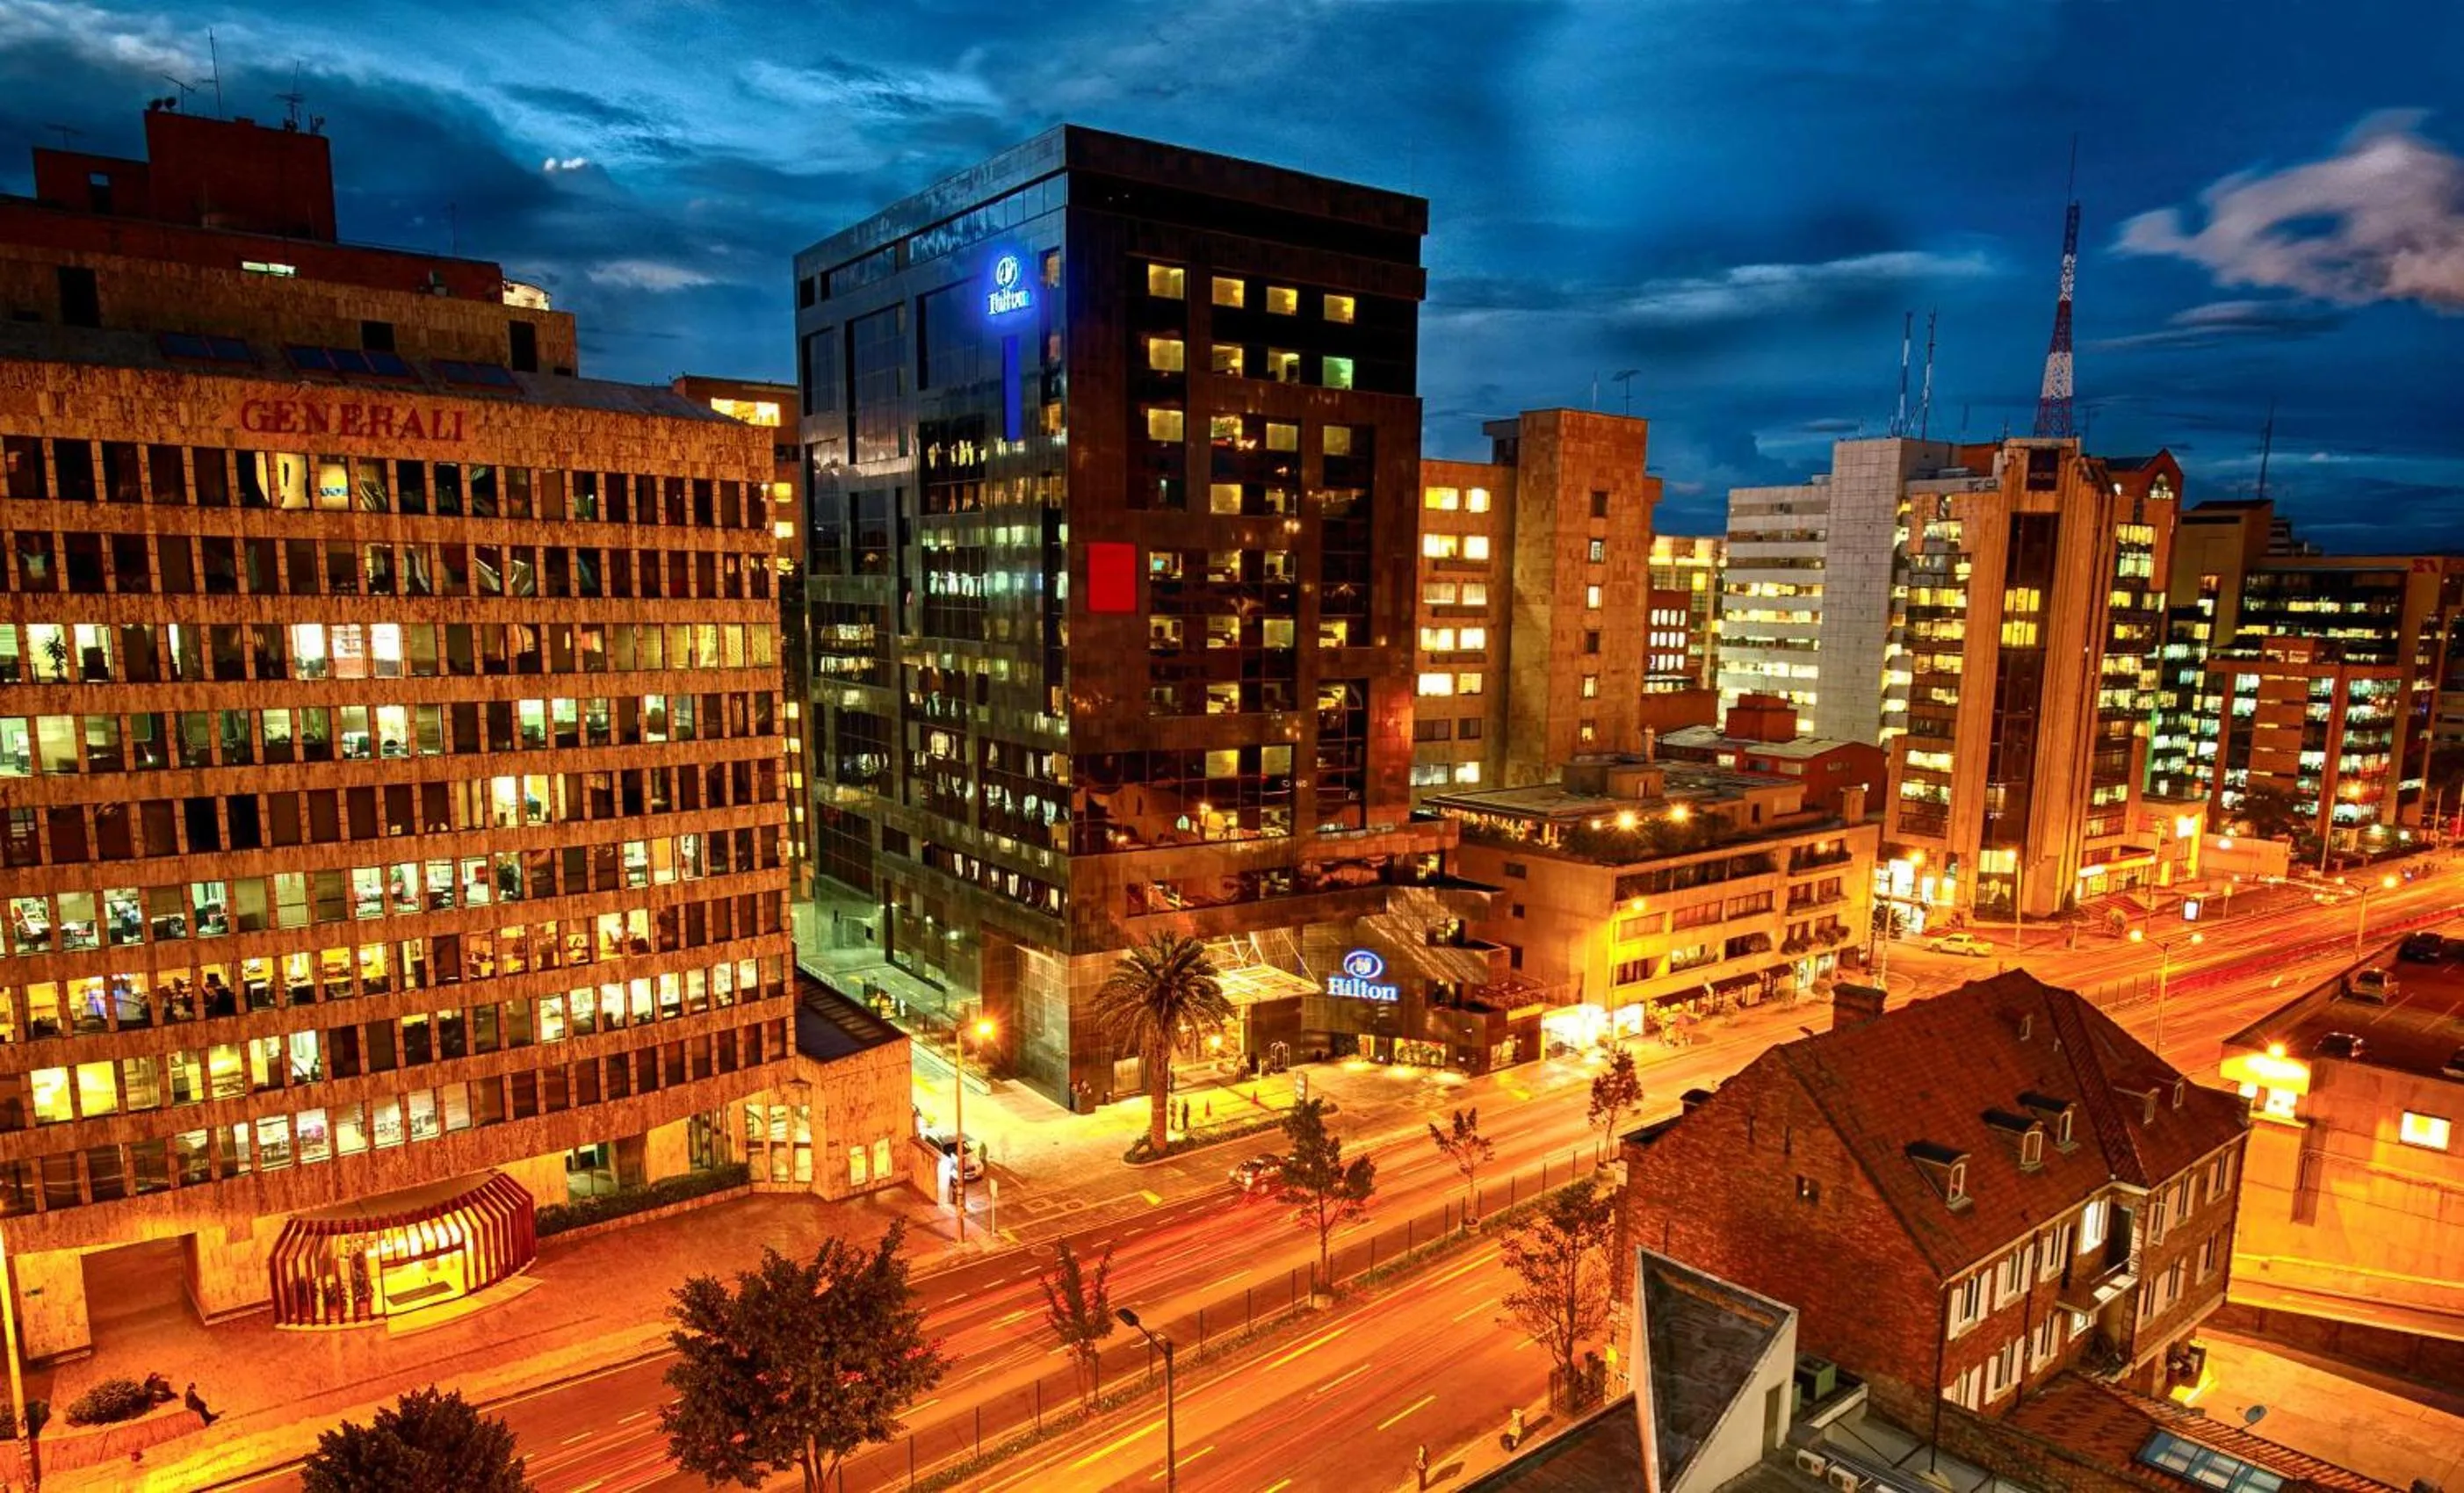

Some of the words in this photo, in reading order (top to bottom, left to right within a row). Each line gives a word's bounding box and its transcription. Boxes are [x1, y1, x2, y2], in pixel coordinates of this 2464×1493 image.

[988, 287, 1030, 315] Hilton
[240, 399, 467, 441] GENERALI
[1327, 977, 1398, 1001] Hilton
